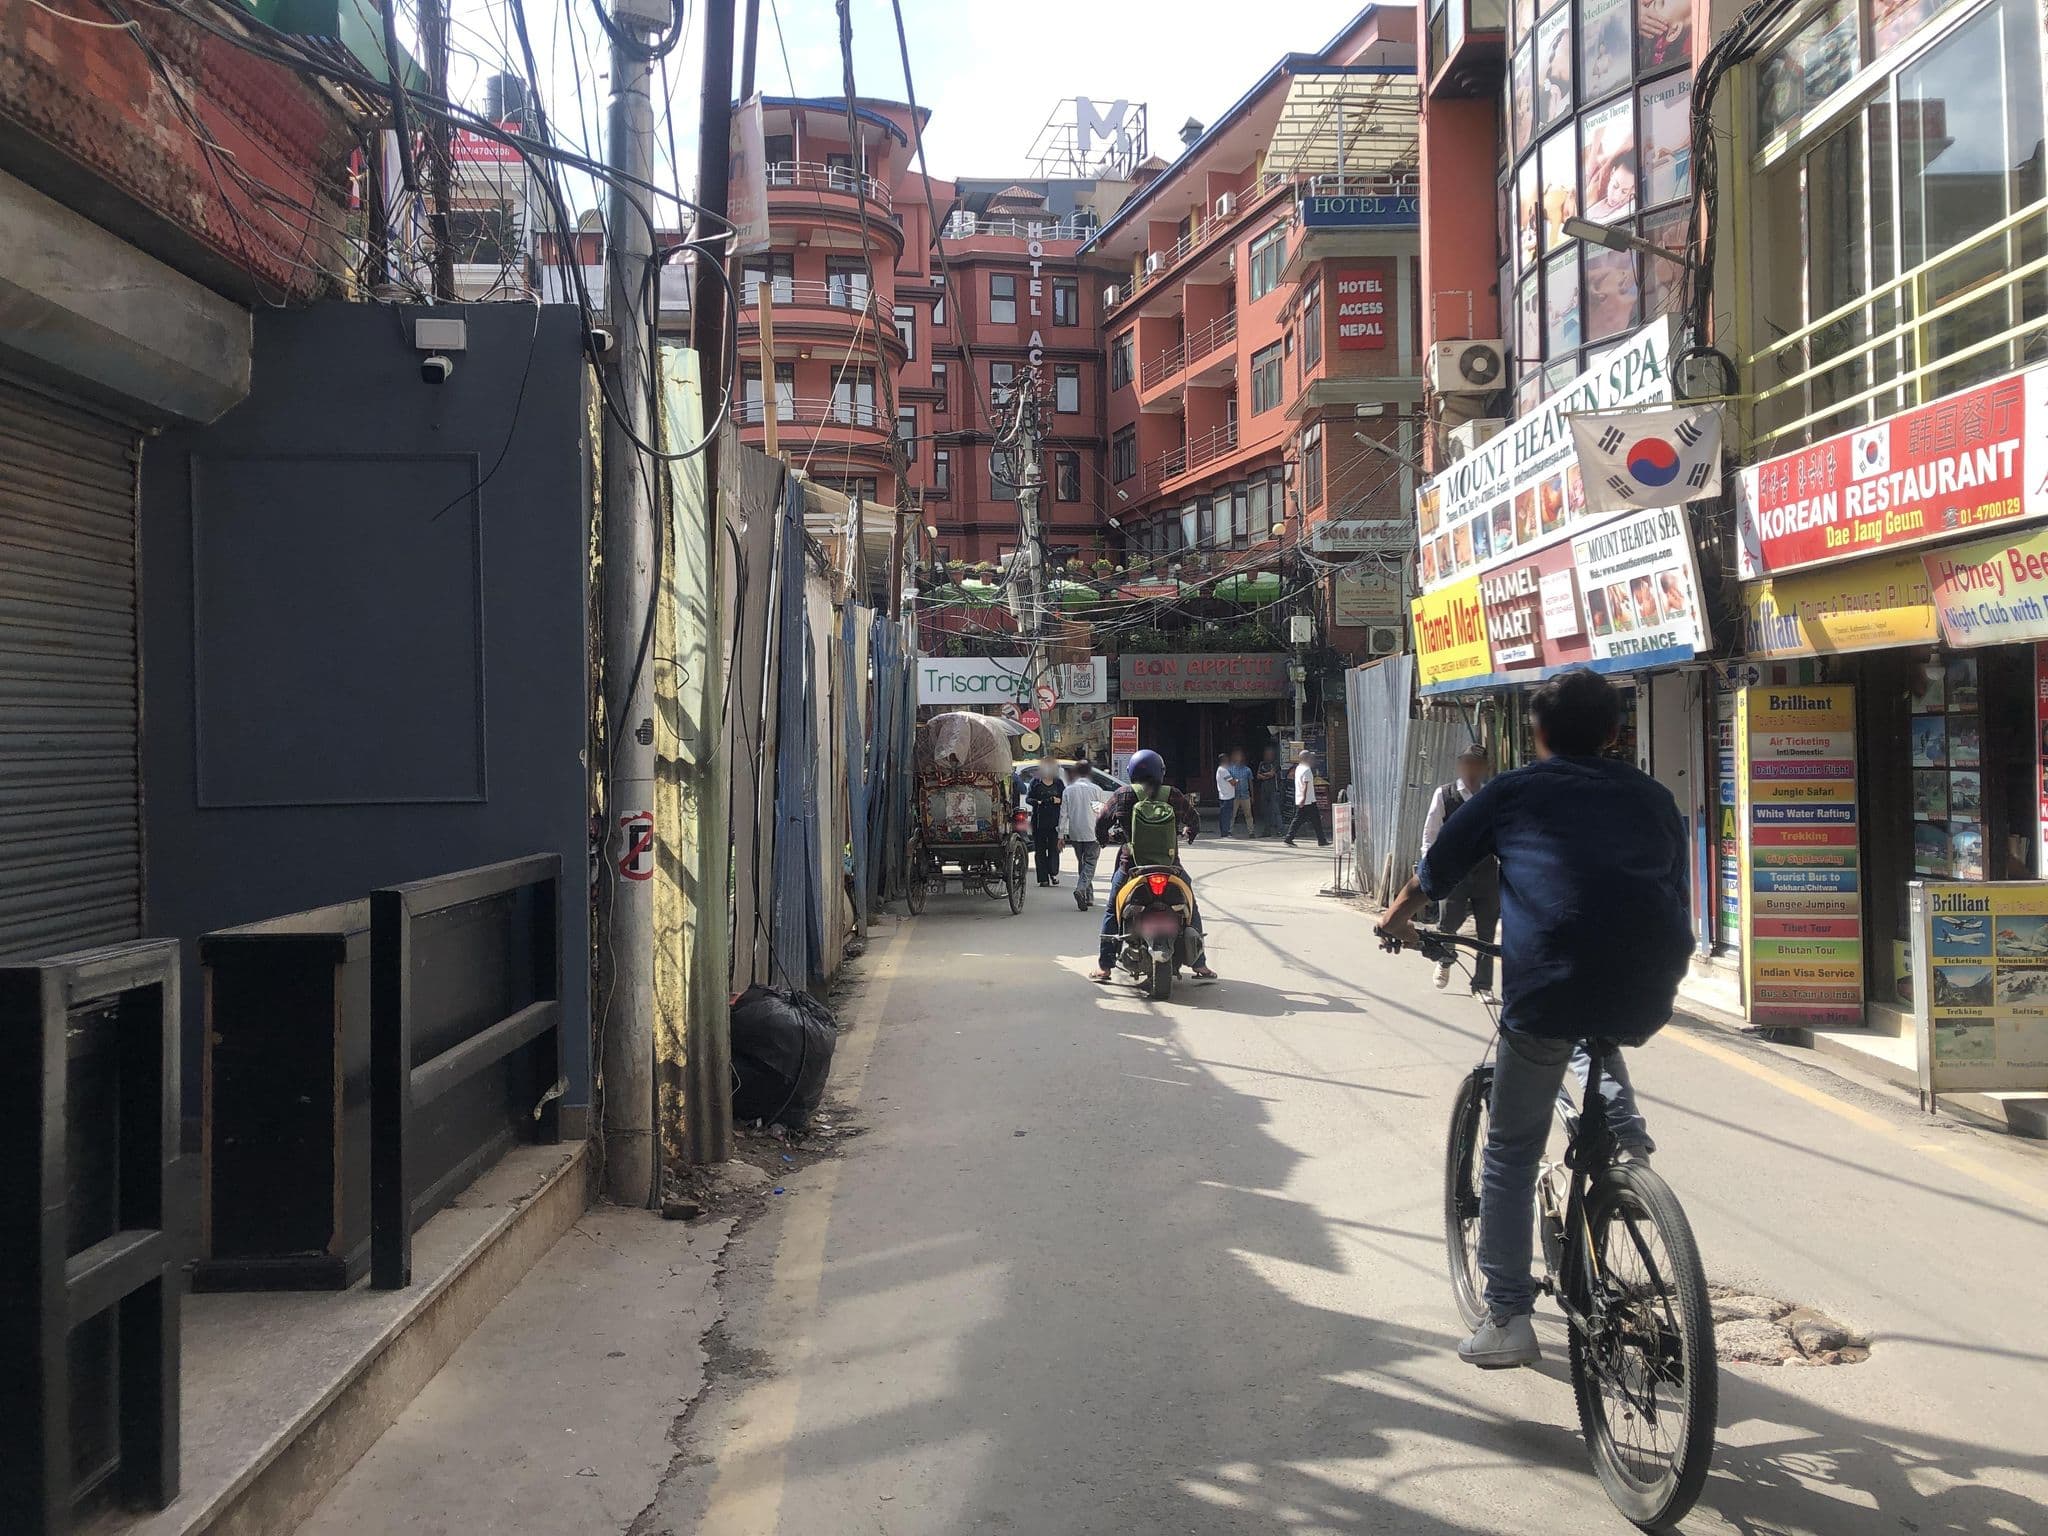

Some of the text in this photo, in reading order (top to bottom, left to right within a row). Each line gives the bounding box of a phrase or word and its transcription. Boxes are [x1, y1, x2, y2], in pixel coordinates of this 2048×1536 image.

[1643, 88, 1674, 107] Steam
[1076, 96, 1128, 153] M
[1314, 198, 1386, 214] HOTEL
[1028, 222, 1043, 316] HOTEL
[1338, 280, 1383, 294] HOTEL
[1339, 302, 1384, 316] ACCESS
[1340, 323, 1383, 337] NEPAL
[1447, 337, 1663, 507] MOUNT HEAVEN SPA
[1908, 383, 2019, 457] 韩国餐厅
[1760, 491, 1838, 541] KOREAN
[1845, 438, 2020, 519] RESTAURANT
[1960, 497, 2021, 526] 01-4700129
[1826, 509, 1924, 548] Dae Jang Geum
[1587, 510, 1681, 564] MOUNT HEAVEN SPA
[1940, 548, 2048, 597] Honey Bee
[1476, 566, 1539, 605] THAMEL
[1832, 596, 1838, 617] &
[1841, 591, 1882, 615] TRAVELS
[1946, 606, 1979, 633] Night
[1979, 601, 2009, 626] Club
[2010, 597, 2042, 622] with
[1415, 595, 1484, 655] Thamel Mart
[1488, 608, 1532, 642] MART
[1608, 632, 1679, 657] ENTRANCE
[1134, 658, 1177, 676] BON
[925, 669, 1013, 693] Trisara
[1770, 695, 1832, 711] Brilliant
[1022, 716, 1039, 724] STOP
[1770, 736, 1830, 748] Air Ticketing
[1756, 764, 1849, 777] Daily Mountain Flight
[1772, 786, 1834, 799] Jungle Safari
[1756, 809, 1850, 820] White Water Rafting
[1780, 831, 1828, 842] Trekking
[1769, 872, 1840, 882] Tourist Bus to
[1774, 884, 1838, 892] Pokhara/Chitwan
[1767, 900, 1846, 910] Bungee Jumping
[1932, 893, 1990, 912] Brilliant
[1782, 923, 1832, 933] Tibet Tour
[1778, 945, 1836, 955] Bhutan Tour
[1943, 957, 1982, 965] Ticketing
[1998, 957, 2033, 965] Mountain
[1760, 967, 1855, 978] Indian Visa Service
[1760, 989, 1777, 998] Bus
[1782, 989, 1788, 998] &
[1792, 990, 1817, 998] Train
[1820, 990, 1830, 999] to
[1946, 1008, 1983, 1016] Trekking
[2012, 1007, 2044, 1016] Rafting
